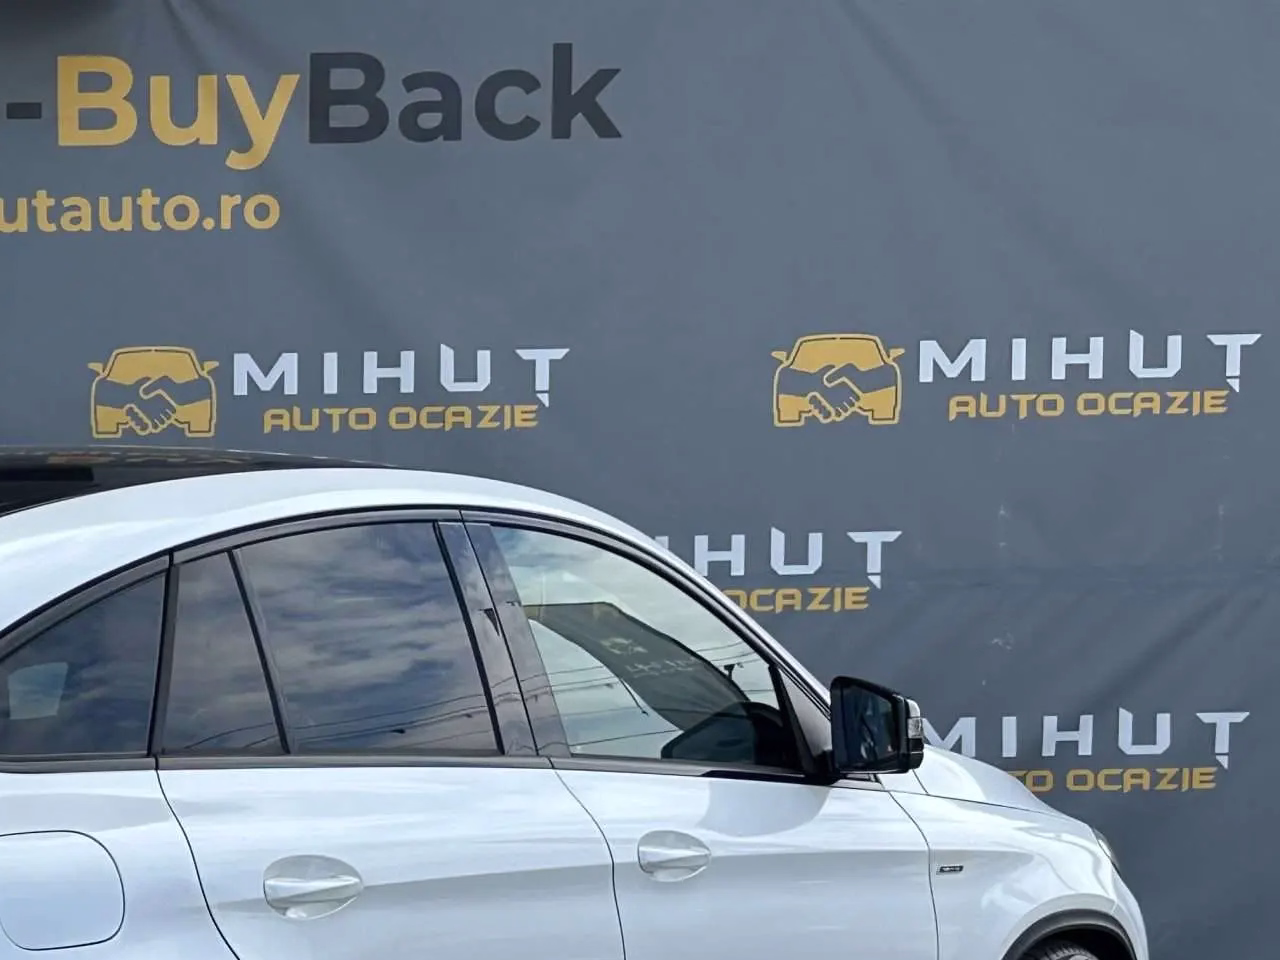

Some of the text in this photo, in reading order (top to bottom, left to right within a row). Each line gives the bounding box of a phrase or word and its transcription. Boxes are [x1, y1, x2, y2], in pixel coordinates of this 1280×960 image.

[263, 404, 541, 433] AUTO OCAZIE
[948, 389, 1231, 421] AUTO OCAZIE
[1066, 766, 1218, 791] OCAZIE
